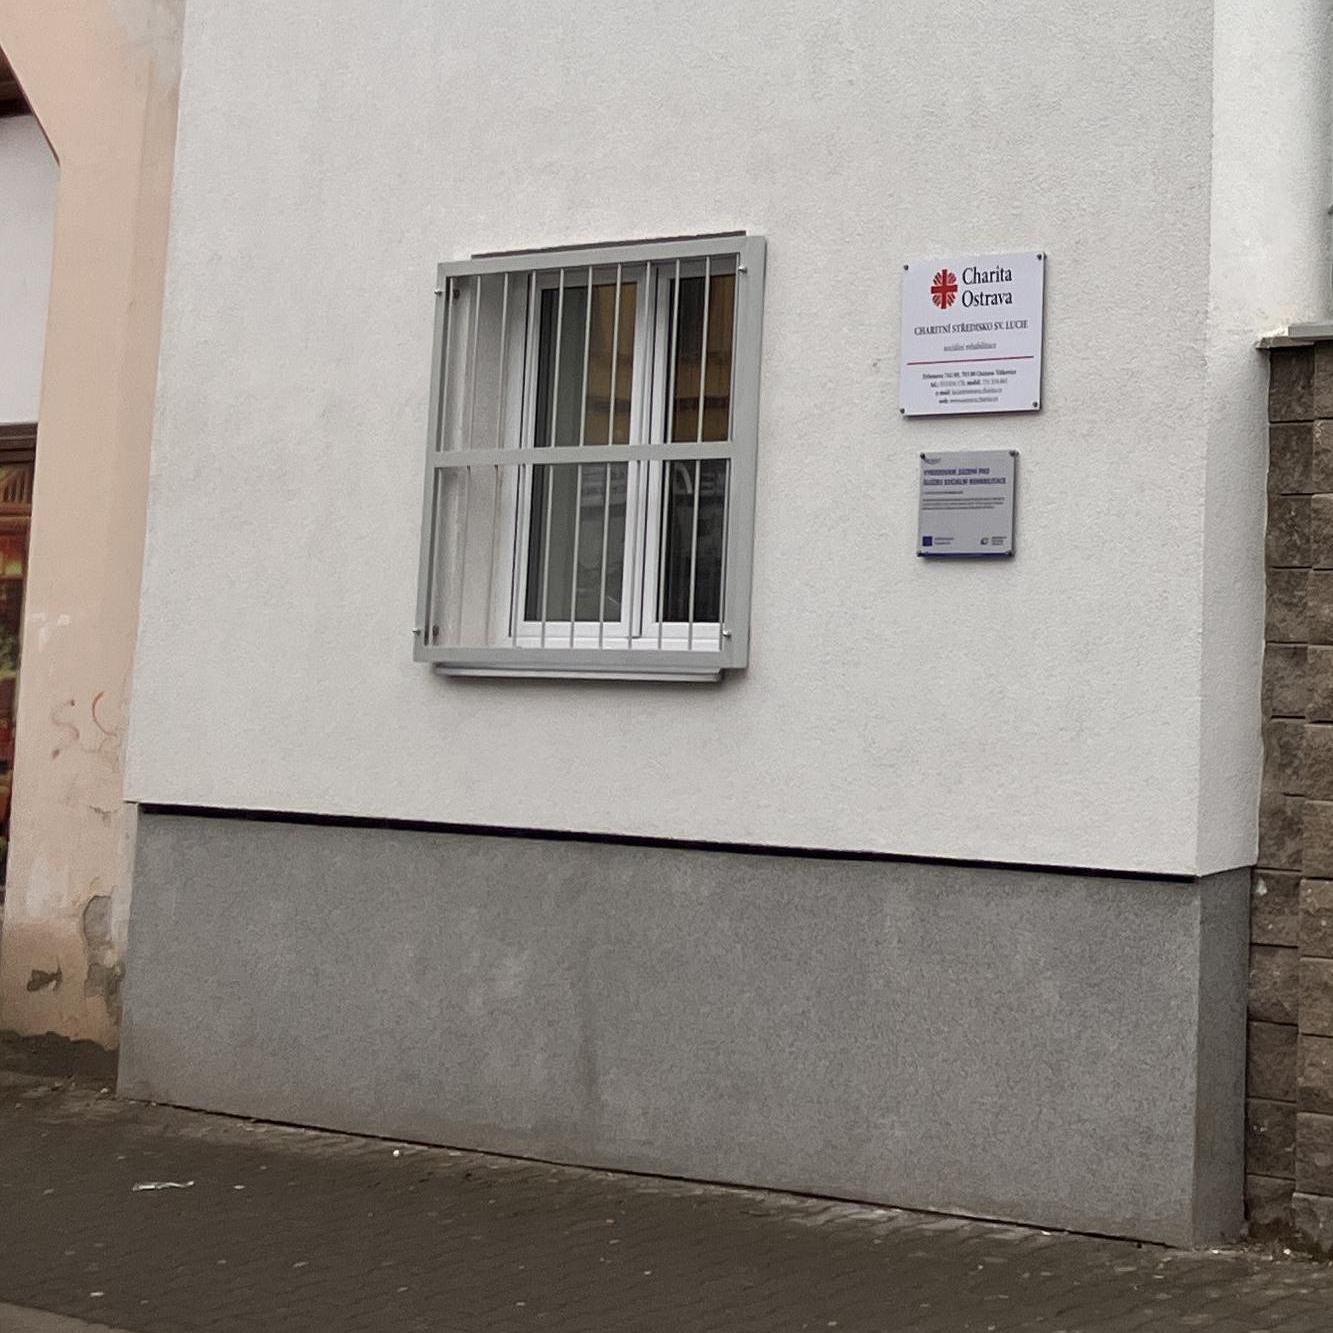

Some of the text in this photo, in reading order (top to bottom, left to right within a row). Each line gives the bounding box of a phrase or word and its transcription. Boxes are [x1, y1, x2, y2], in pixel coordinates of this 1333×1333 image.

[962, 266, 1012, 285] Charita
[962, 290, 1013, 307] Ostrava
[1005, 319, 1029, 330] LUCIE
